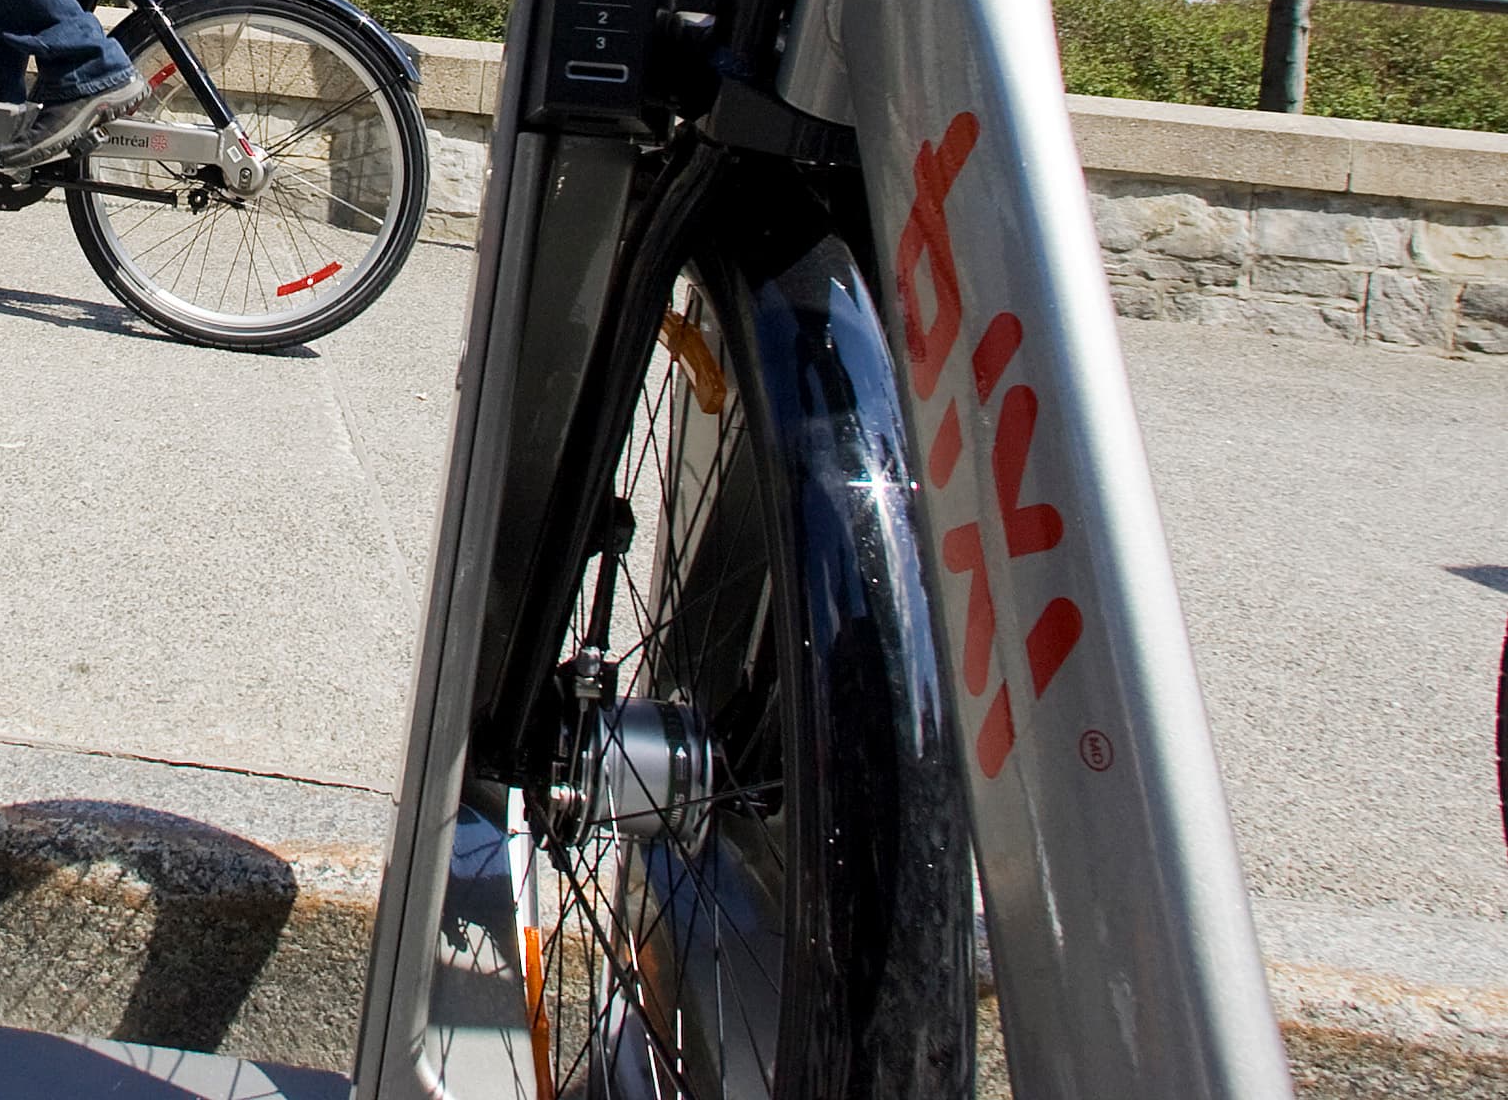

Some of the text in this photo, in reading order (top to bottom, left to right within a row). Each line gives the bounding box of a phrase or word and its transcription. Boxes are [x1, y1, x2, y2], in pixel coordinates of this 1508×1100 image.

[598, 12, 609, 24] 2
[595, 37, 606, 50] 3
[105, 135, 150, 148] ontréal
